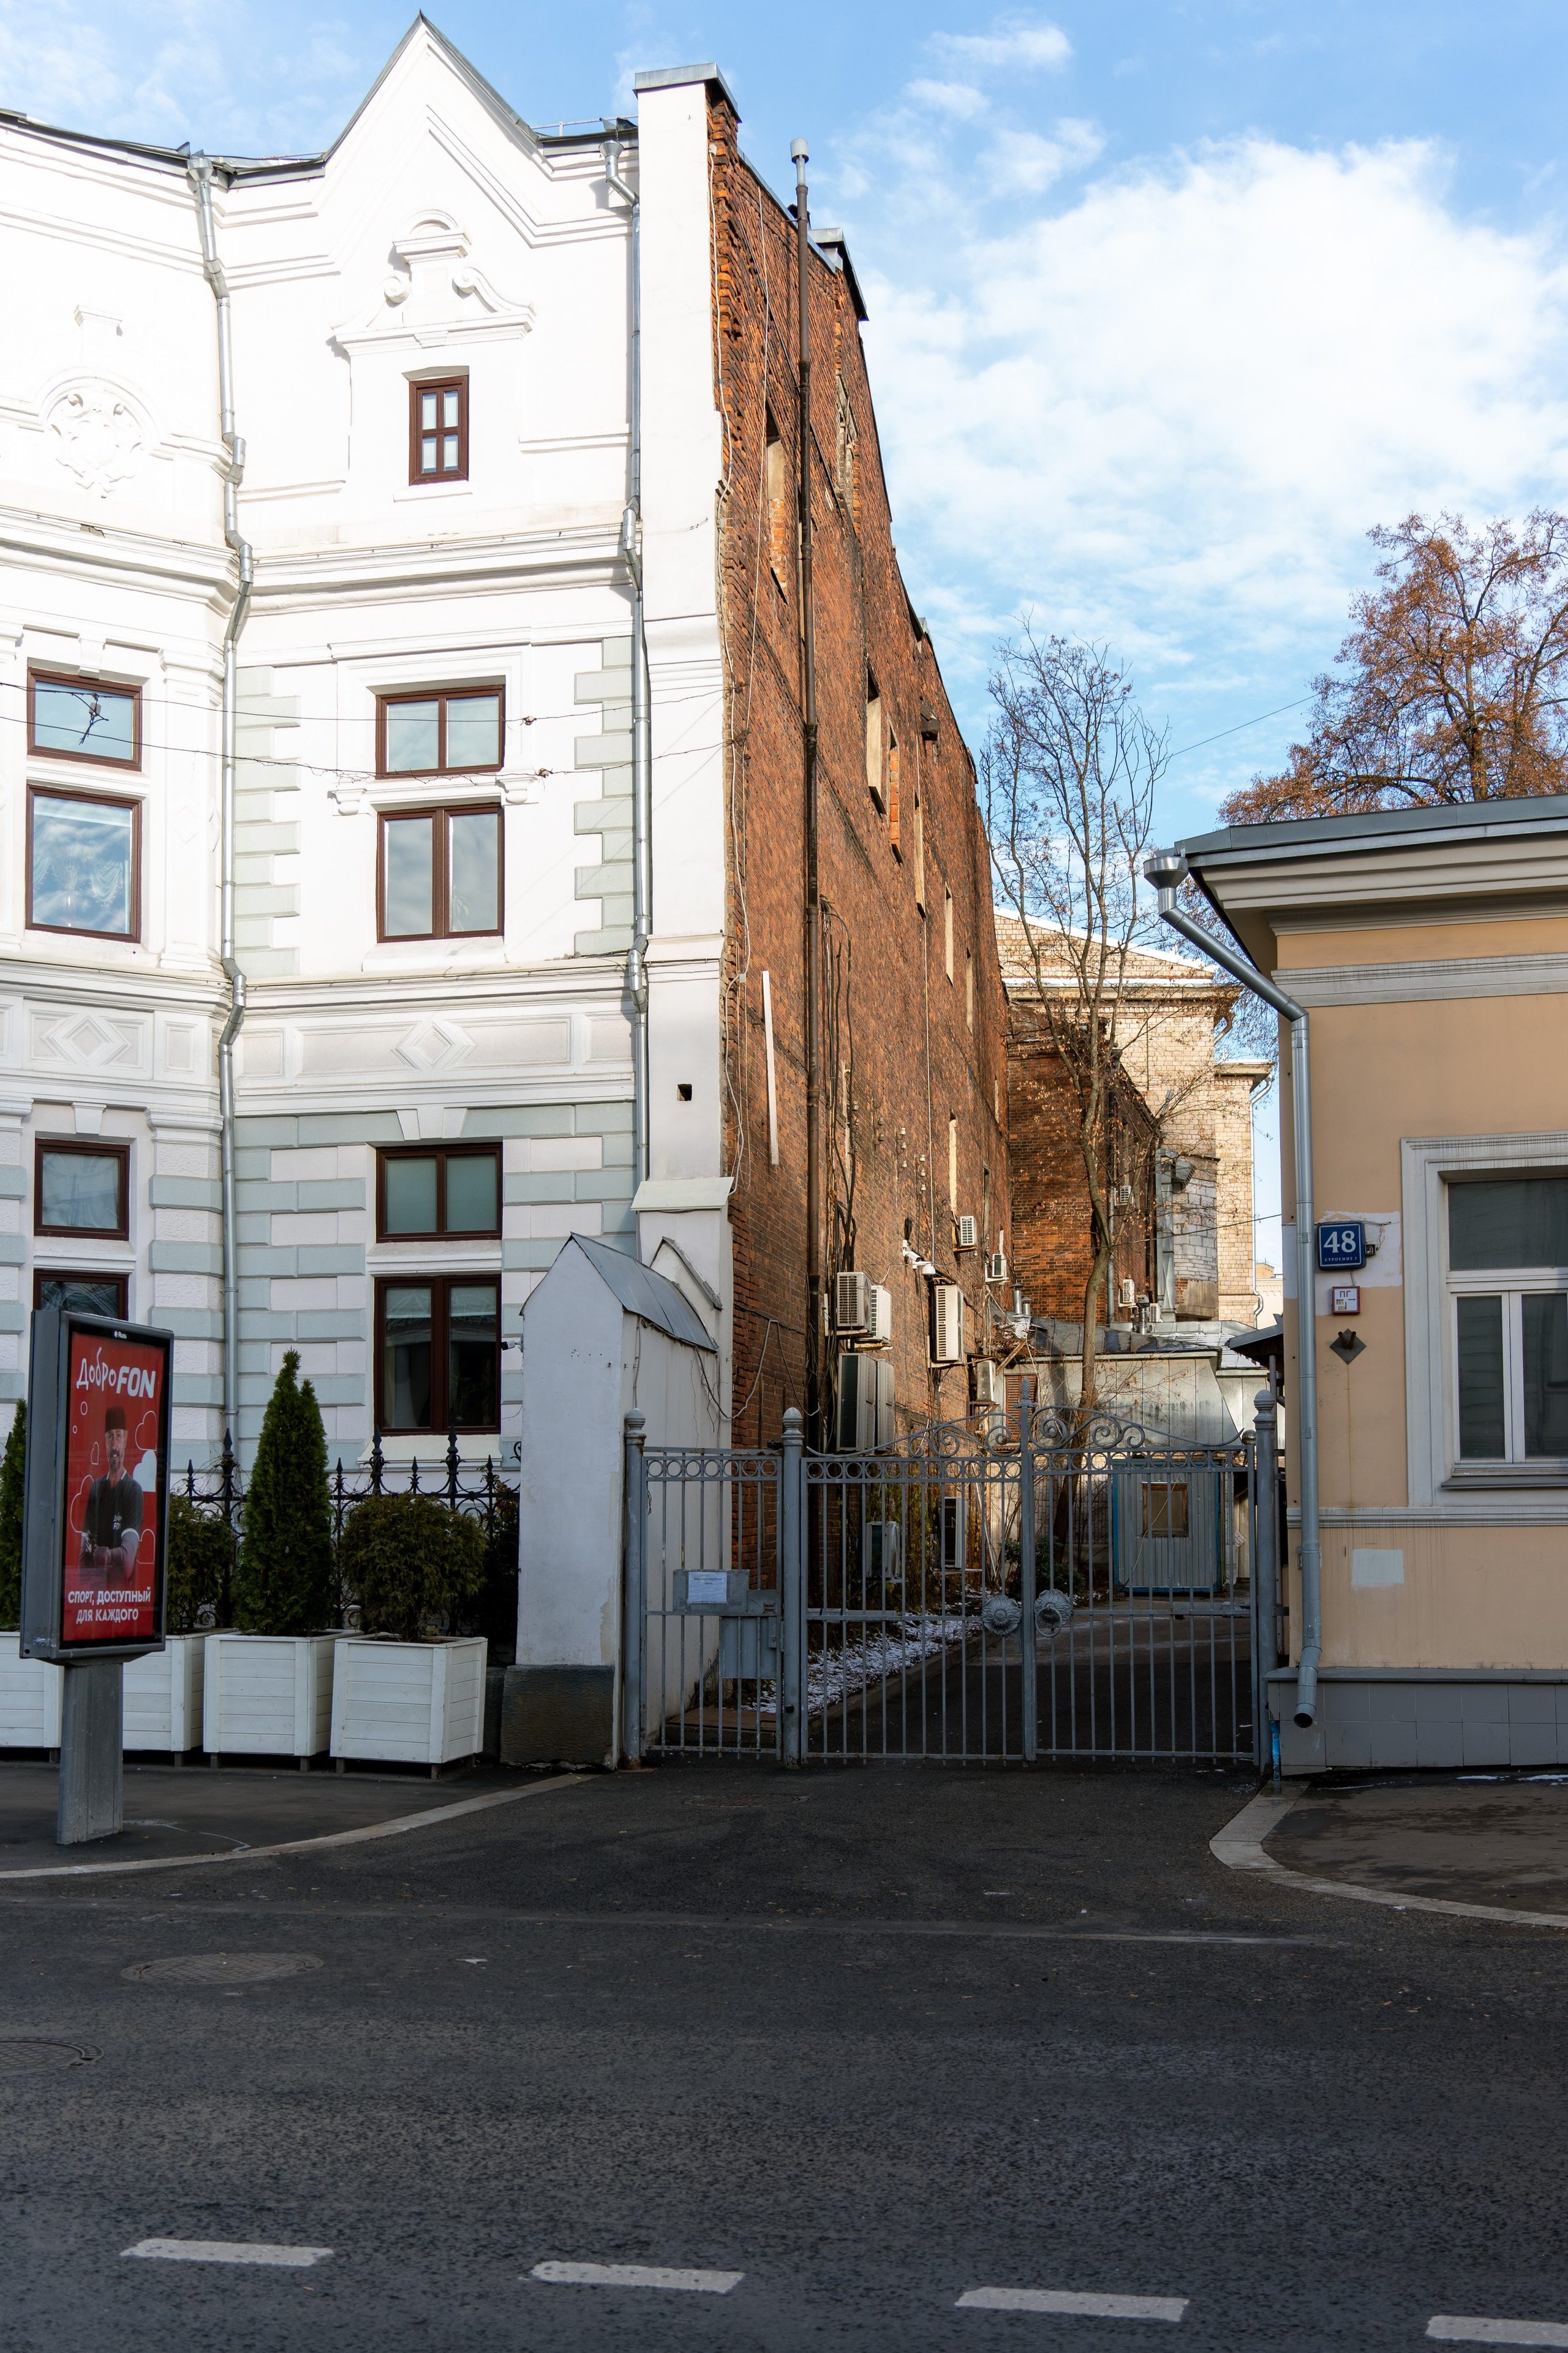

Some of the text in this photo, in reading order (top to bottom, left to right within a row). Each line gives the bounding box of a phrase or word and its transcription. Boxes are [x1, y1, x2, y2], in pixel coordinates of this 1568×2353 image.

[1324, 1230, 1356, 1253] 48
[68, 1586, 151, 1606] СПОРТ, ДОСТУПНЫЙ
[75, 1608, 139, 1624] ДЛЯ КАЖДОГО
